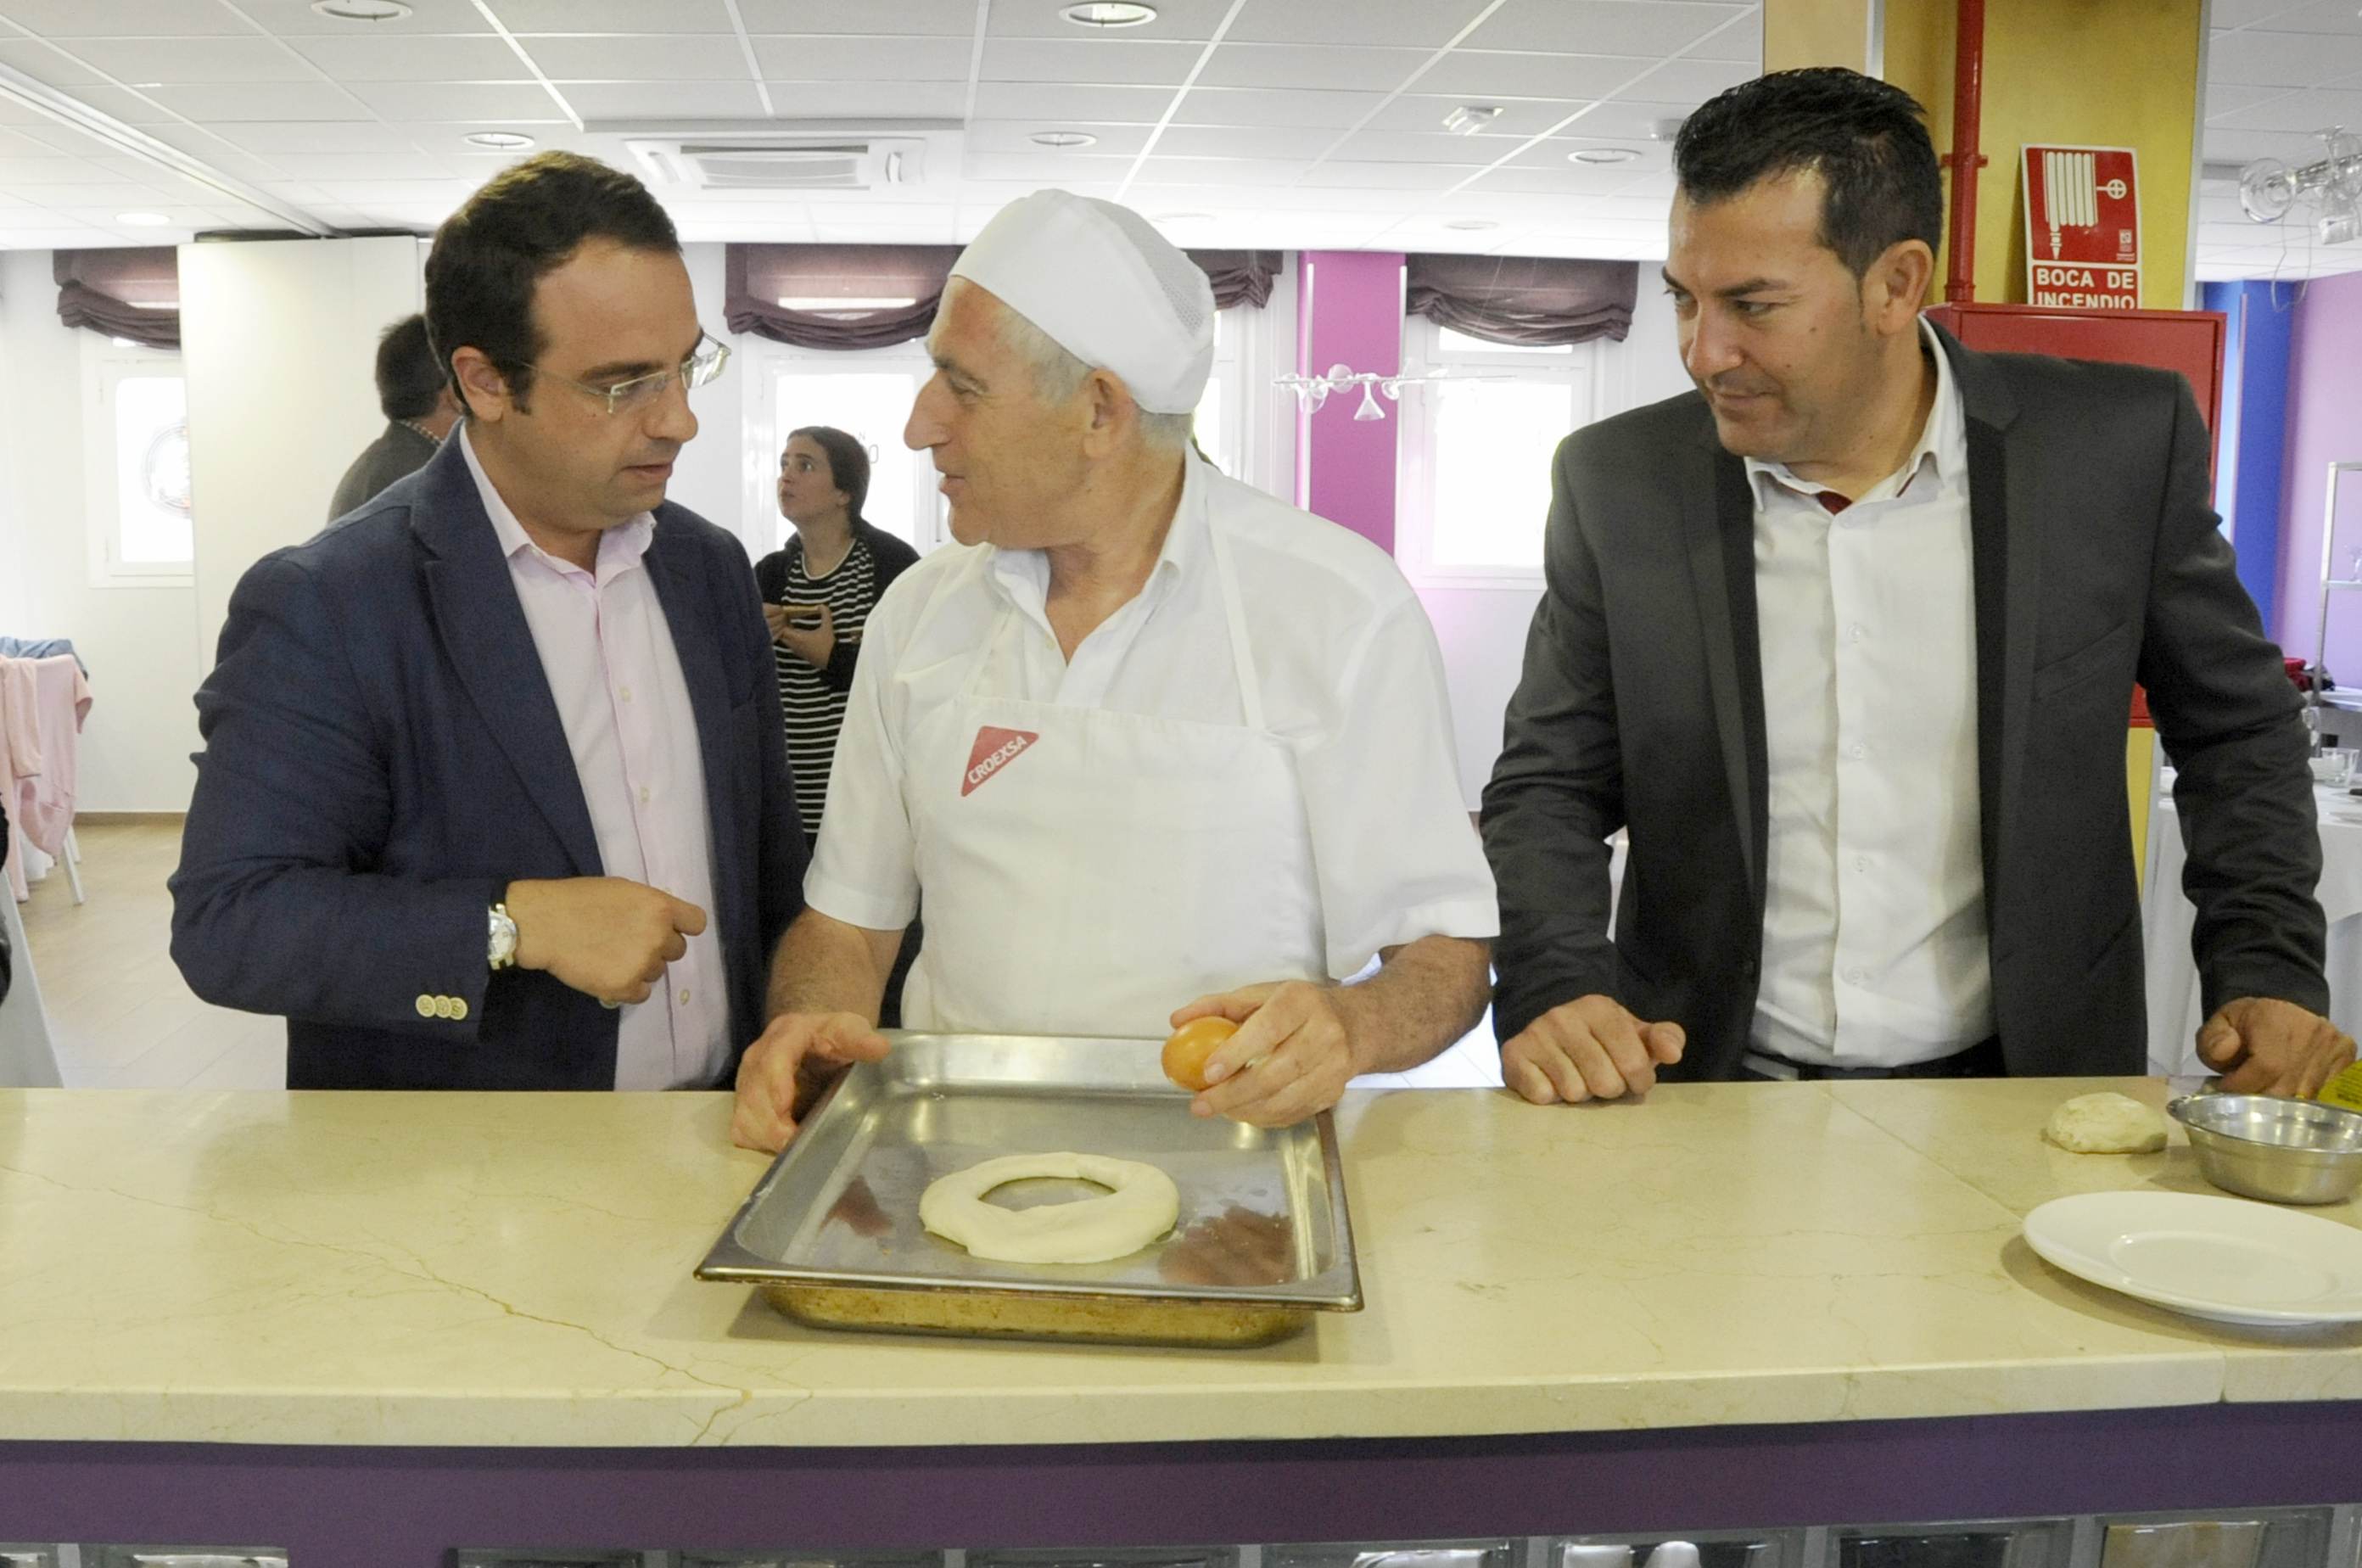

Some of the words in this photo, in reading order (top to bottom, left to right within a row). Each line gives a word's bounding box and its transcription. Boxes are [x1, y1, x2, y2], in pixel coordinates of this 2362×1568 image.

[2037, 268, 2095, 287] BOCA
[2107, 272, 2135, 288] DE
[2038, 292, 2135, 309] INCENDIO
[968, 736, 1027, 784] CROEXSA
